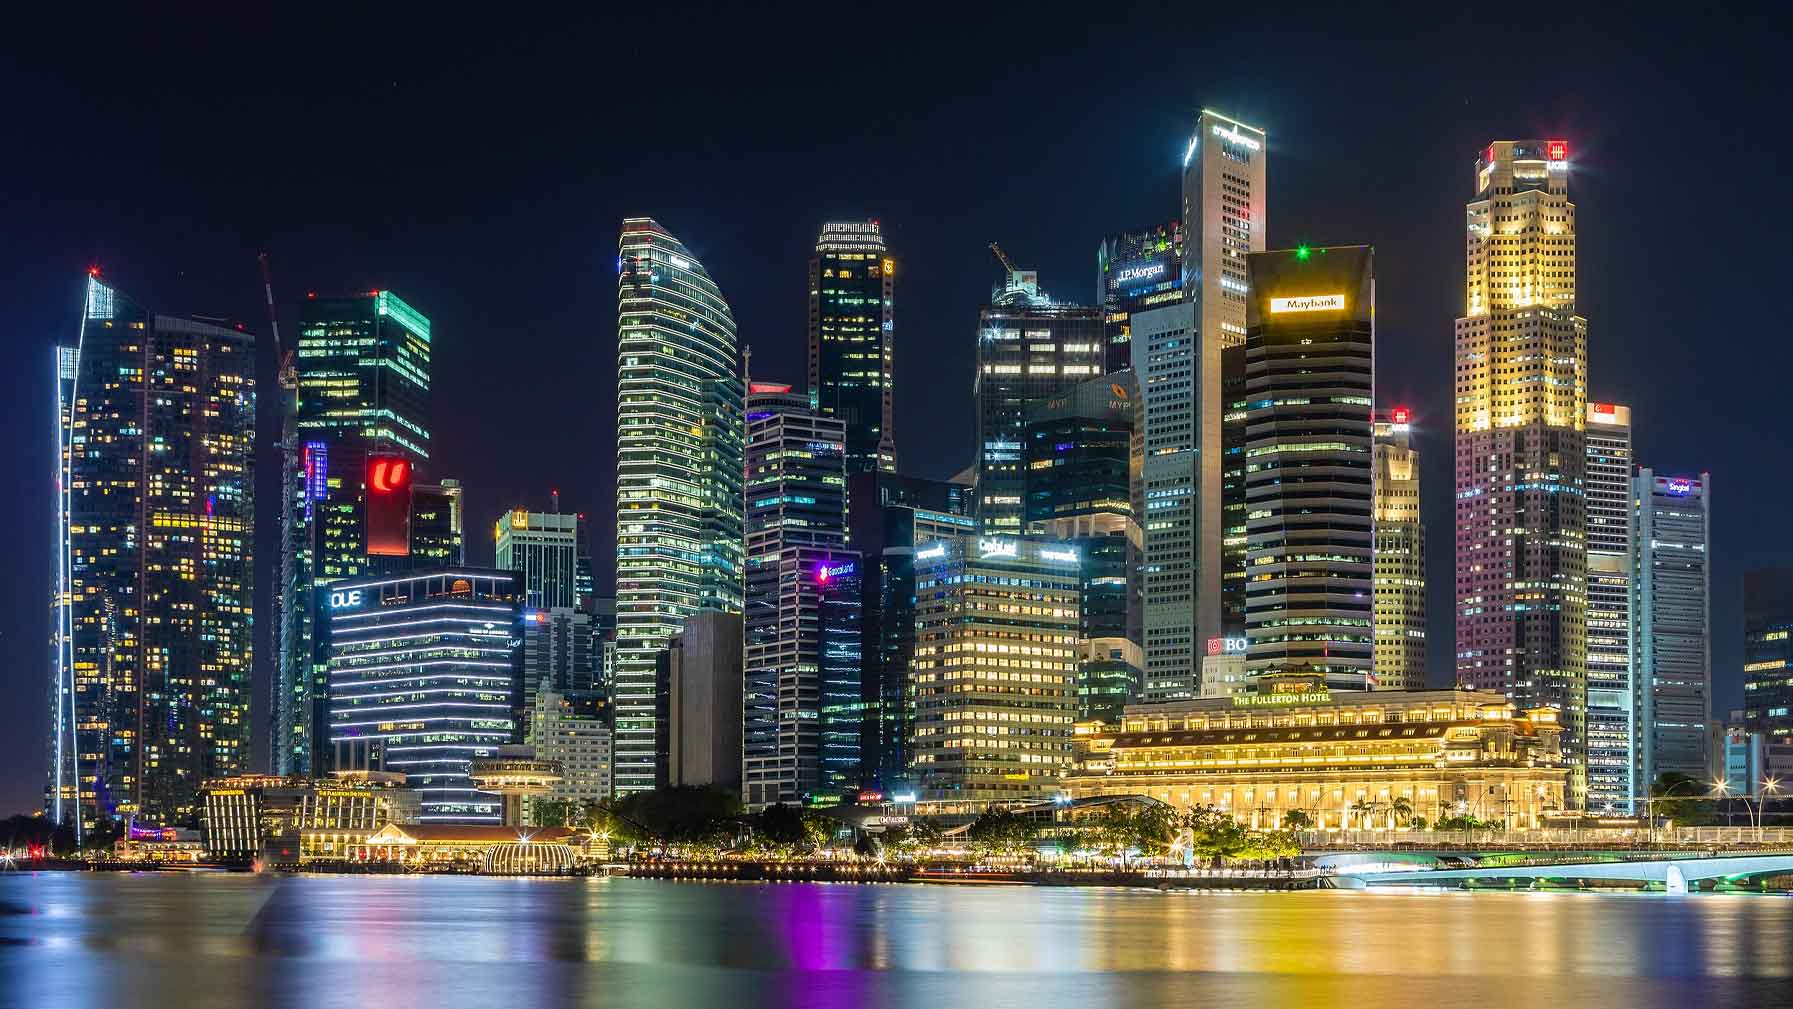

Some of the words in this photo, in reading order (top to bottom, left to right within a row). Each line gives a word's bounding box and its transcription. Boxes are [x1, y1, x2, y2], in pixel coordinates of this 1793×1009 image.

[1287, 298, 1336, 310] Maybank
[331, 591, 361, 608] OUE
[1233, 697, 1250, 705] THE
[1251, 695, 1299, 704] FULLERTON
[1301, 693, 1331, 703] HOTEL
